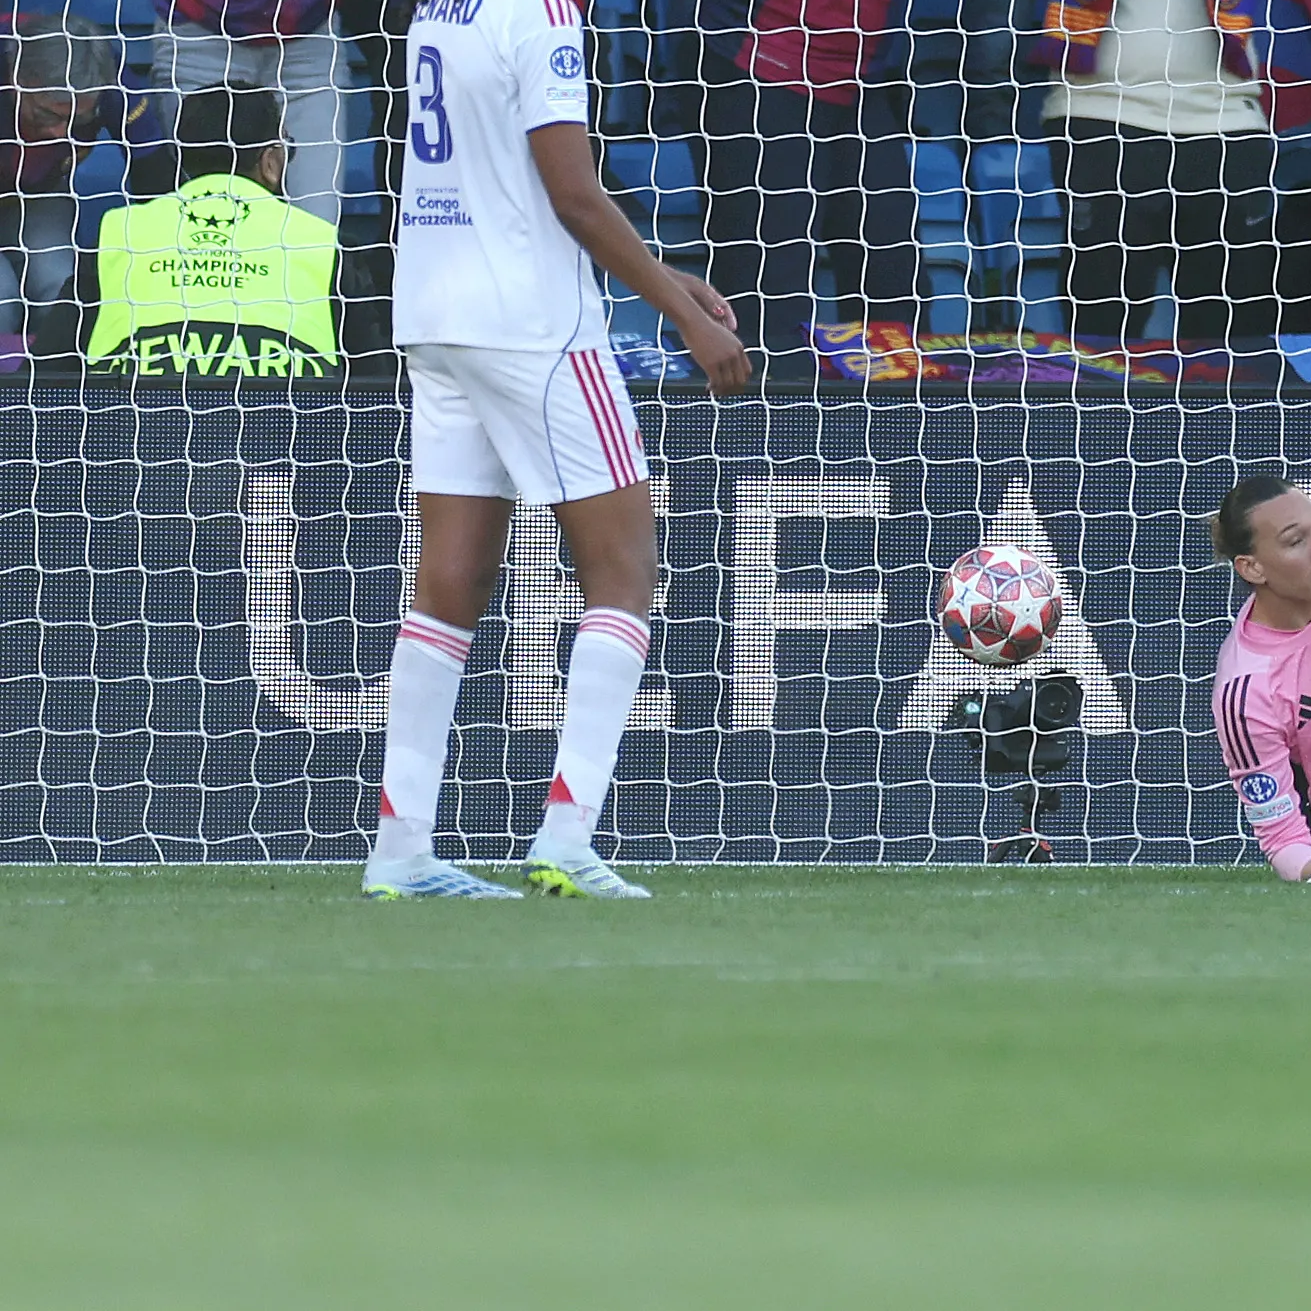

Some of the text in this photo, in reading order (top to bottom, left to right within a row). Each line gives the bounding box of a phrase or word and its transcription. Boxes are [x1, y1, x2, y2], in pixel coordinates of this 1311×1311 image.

[411, 45, 453, 165] 3
[416, 196, 460, 213] Congo
[190, 232, 229, 247] UEFA
[149, 258, 269, 276] CHAMPIONS
[170, 274, 246, 289] LEAGUE
[246, 472, 1129, 733] UEFA
